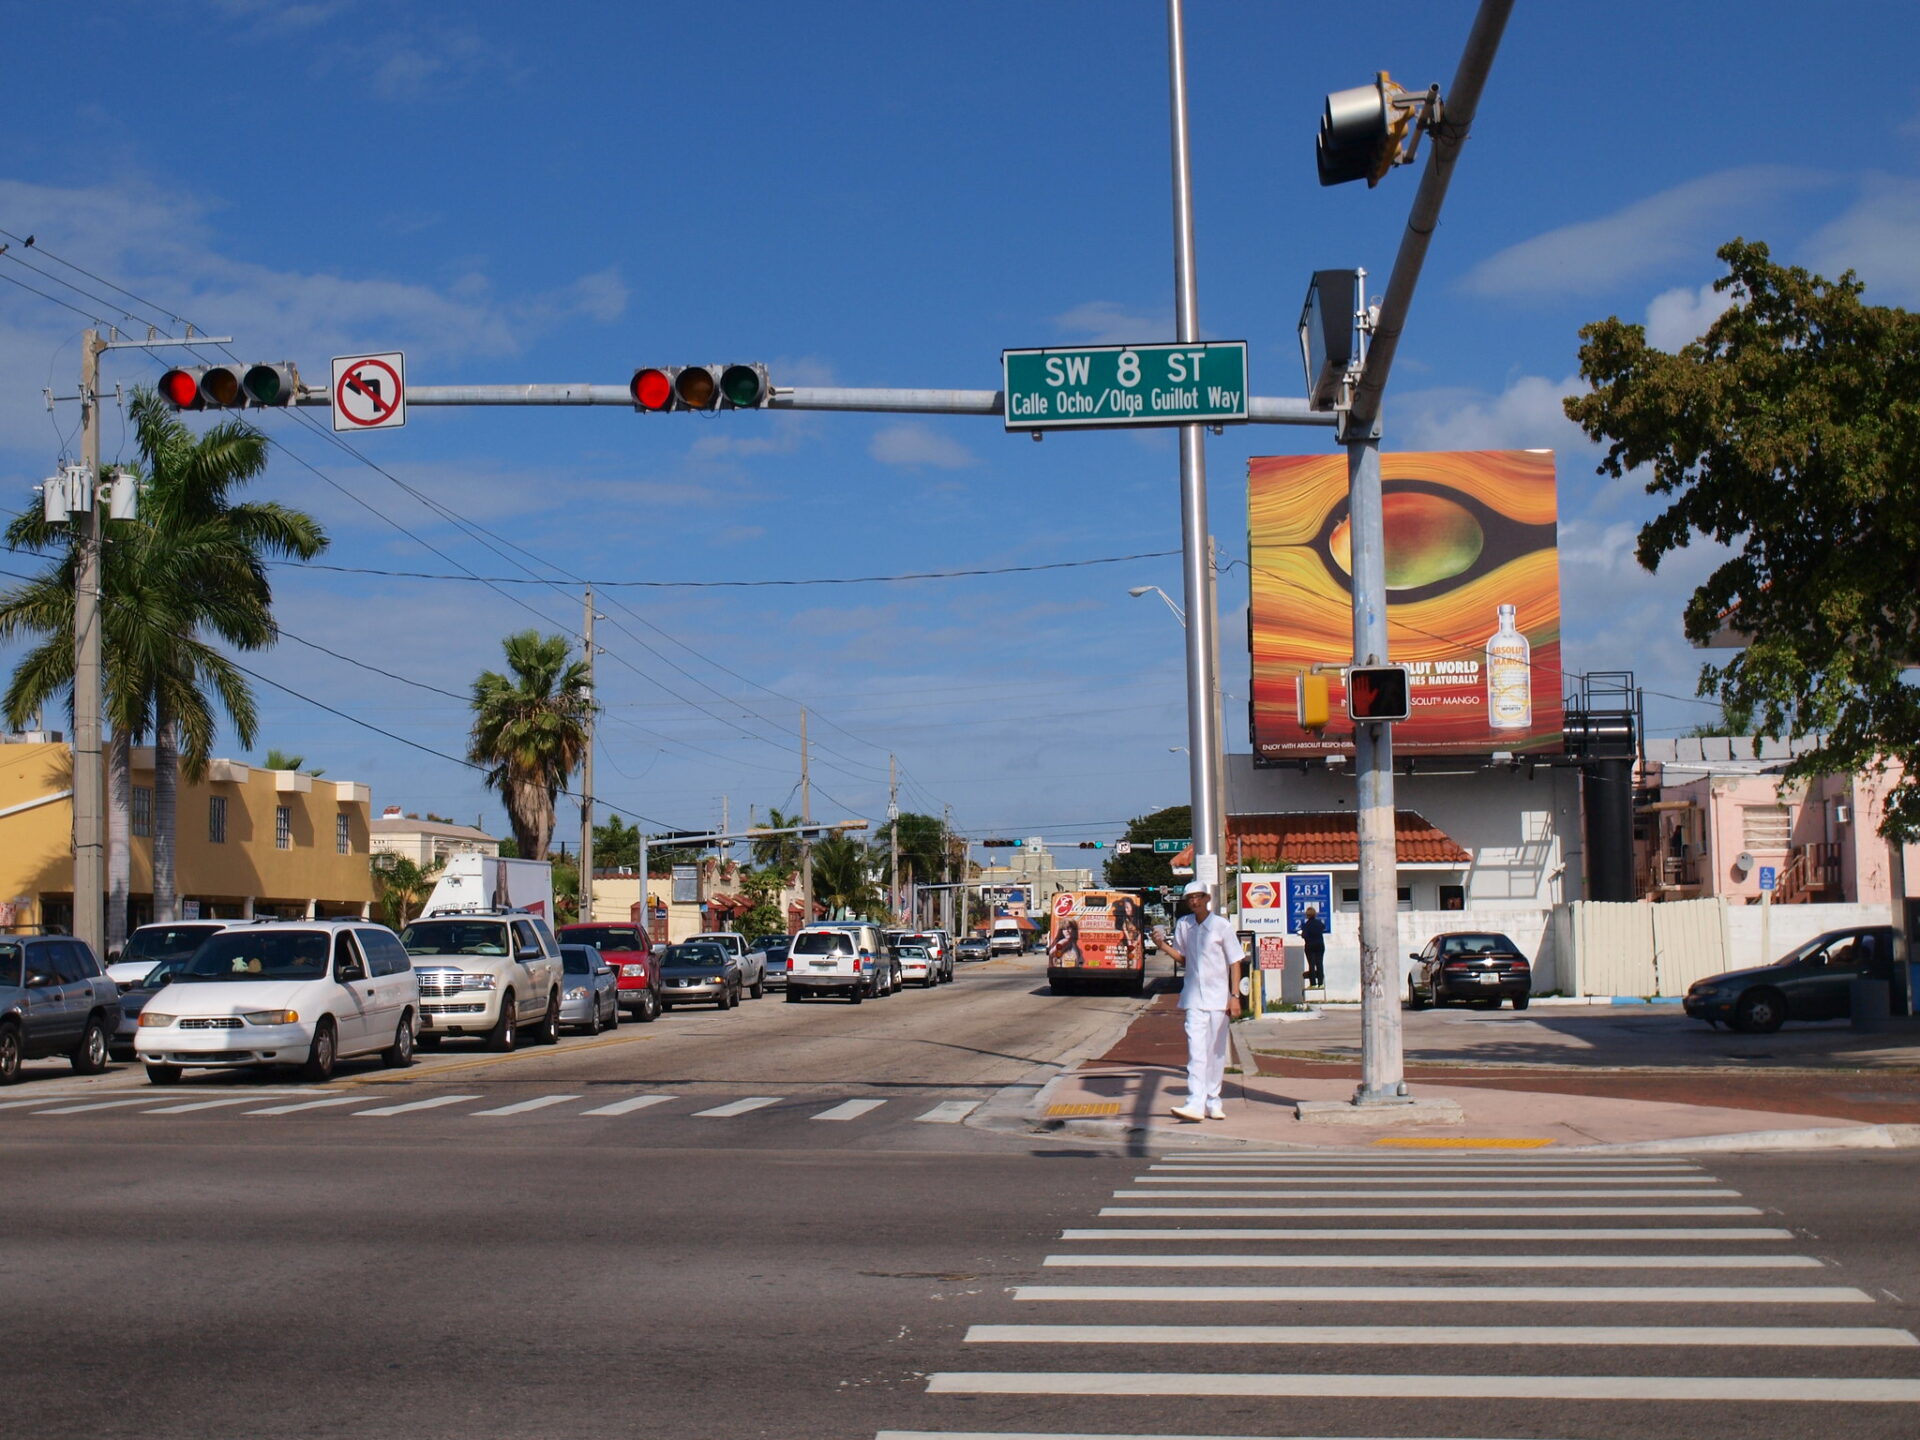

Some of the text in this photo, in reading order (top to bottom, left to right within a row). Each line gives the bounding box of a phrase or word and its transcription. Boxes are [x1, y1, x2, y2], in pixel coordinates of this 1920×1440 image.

[1045, 351, 1206, 388] SW 8 ST
[1012, 386, 1240, 418] Calle Ocho/Olga Guillot Way
[1434, 661, 1479, 675] WORLD
[1428, 675, 1479, 685] NATURALLY
[1443, 696, 1480, 705] MANGO
[1158, 842, 1169, 850] SW
[1172, 842, 1178, 850] 7
[1294, 884, 1319, 896] 2.63
